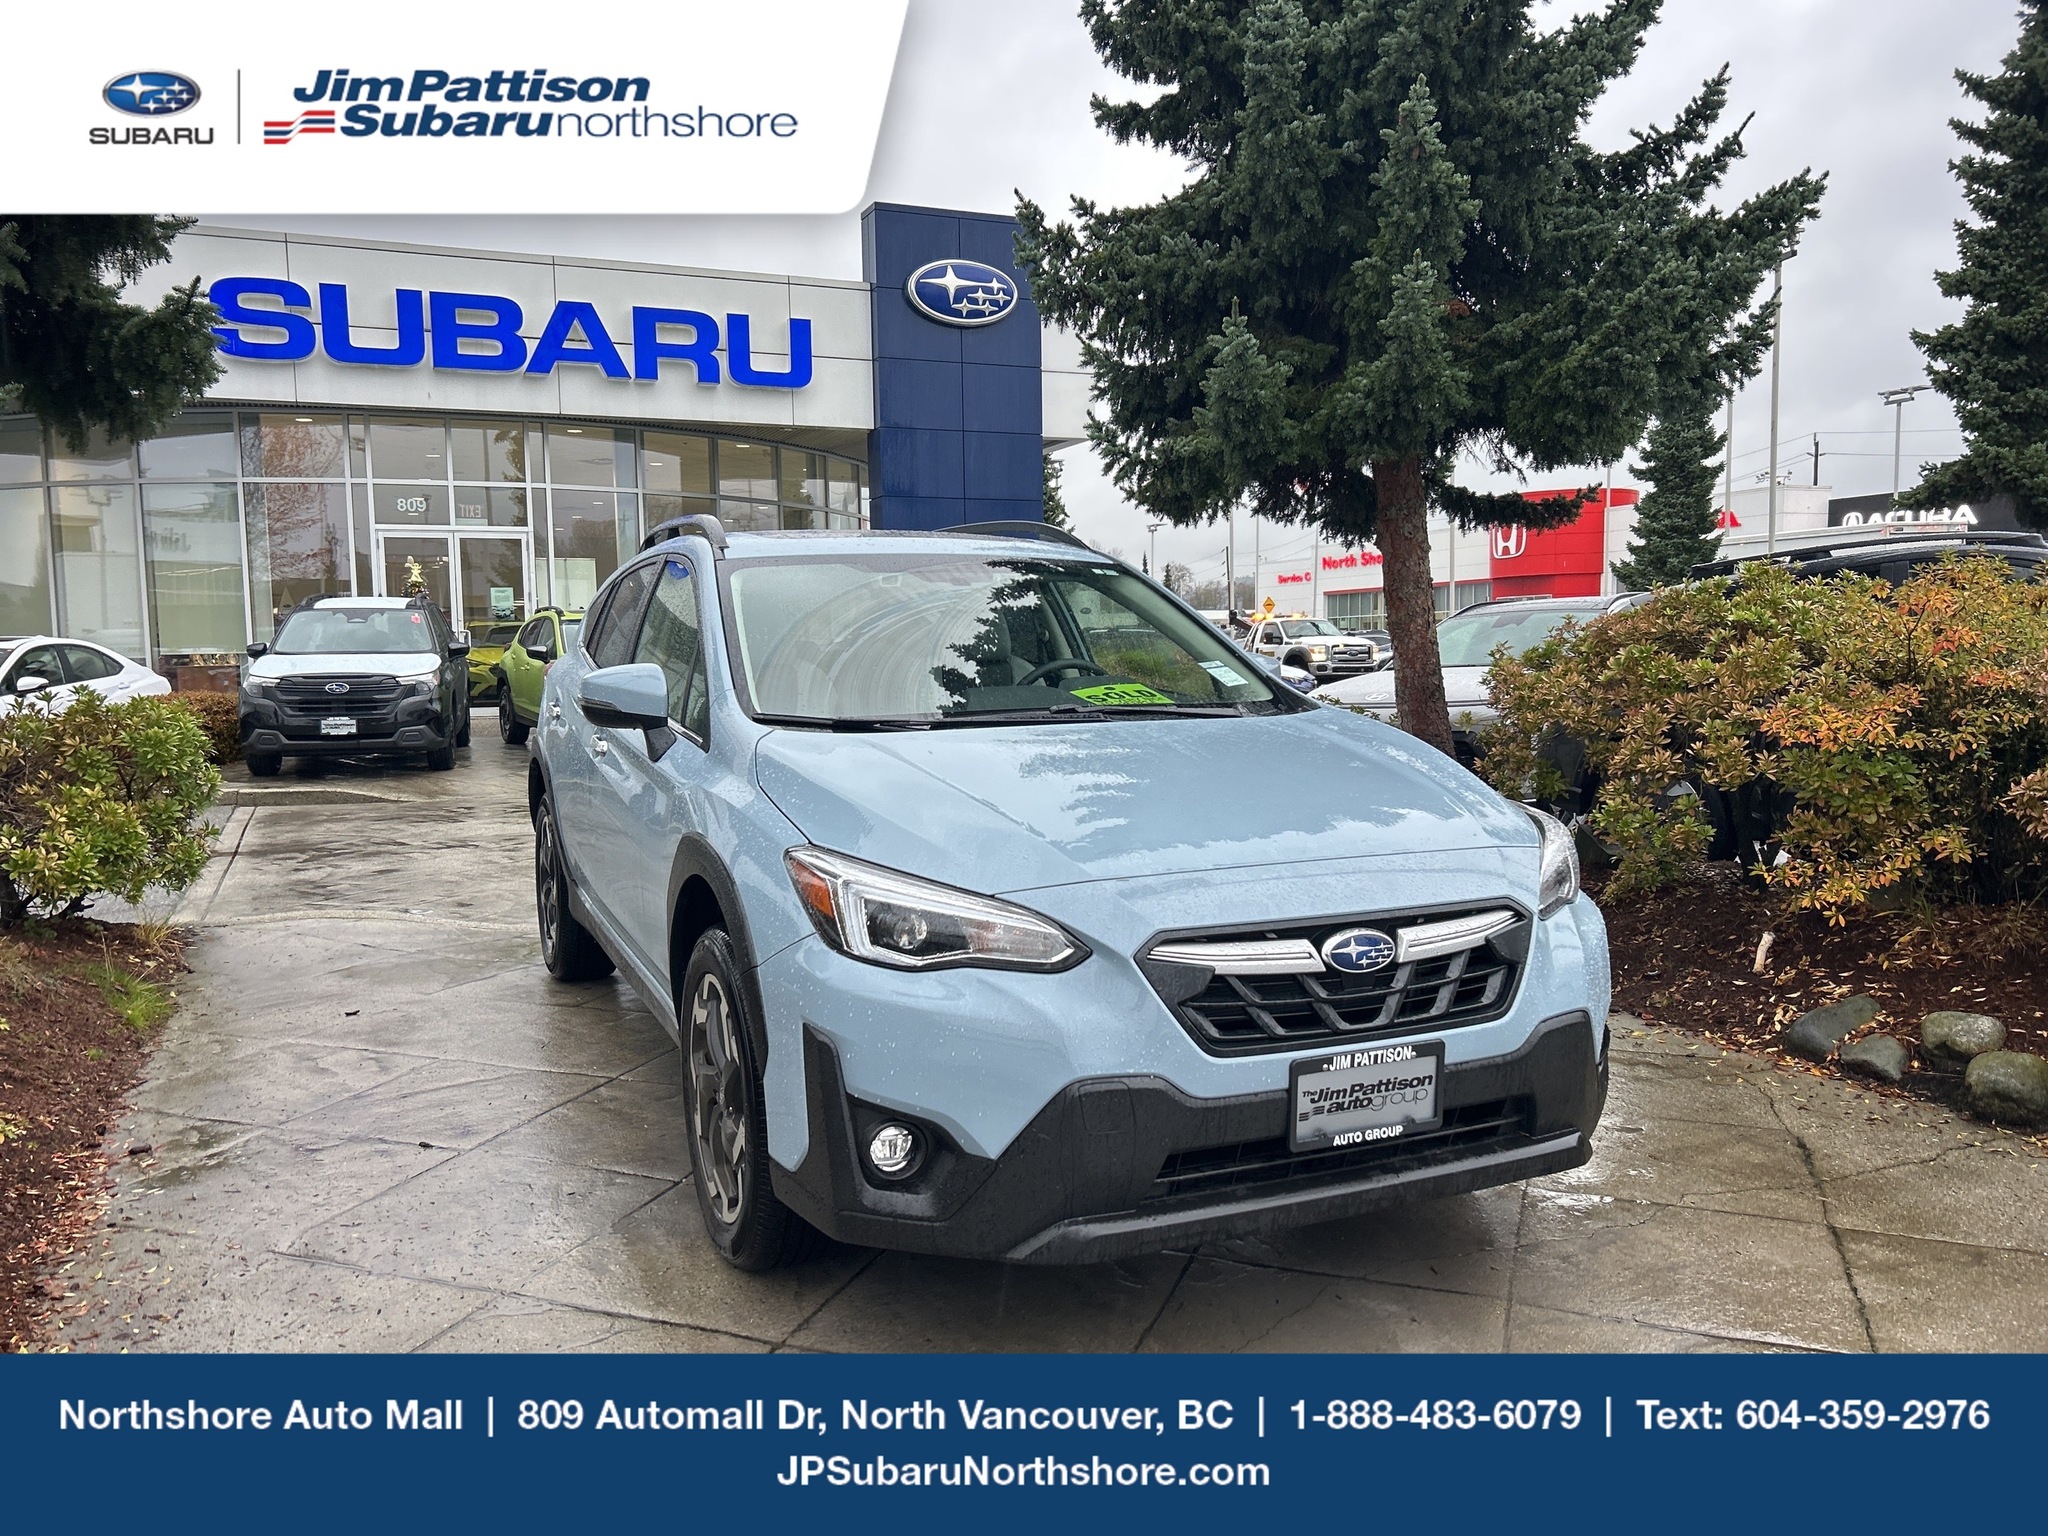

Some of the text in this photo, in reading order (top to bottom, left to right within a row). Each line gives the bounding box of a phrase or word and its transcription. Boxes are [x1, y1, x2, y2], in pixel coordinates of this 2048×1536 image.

[209, 278, 813, 389] SUBARU
[397, 498, 427, 512] 809
[1321, 553, 1358, 570] North
[1085, 689, 1157, 703] SOLD
[1330, 1045, 1413, 1072] JIM PATTISON
[1302, 1074, 1434, 1104] The Jim Pattison
[1333, 1124, 1404, 1147] AUTO GROUP
